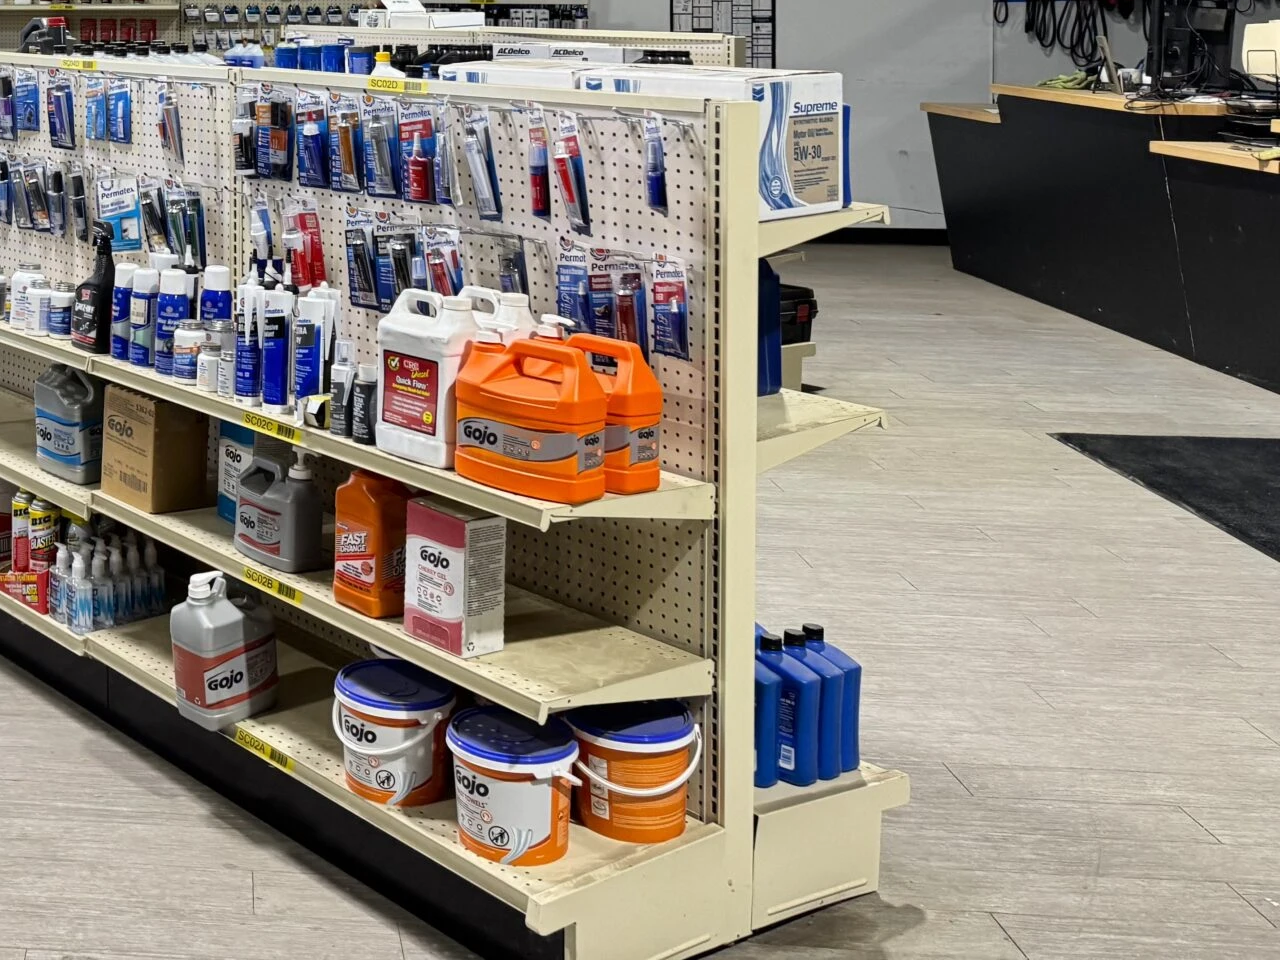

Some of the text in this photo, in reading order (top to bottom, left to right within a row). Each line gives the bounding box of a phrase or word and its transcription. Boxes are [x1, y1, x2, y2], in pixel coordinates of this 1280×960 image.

[497, 47, 531, 55] ACDelco
[370, 78, 398, 90] SC02D
[793, 100, 838, 116] Supreme
[400, 109, 432, 121] Permatex
[793, 129, 808, 139] Motor
[793, 144, 822, 161] 5W-30
[101, 187, 135, 200] Permatex
[591, 262, 641, 272] Permatex
[655, 269, 685, 279] Permatex
[403, 359, 419, 371] CRC
[411, 369, 430, 379] Diesel
[395, 375, 428, 390] Quick Flow
[244, 413, 274, 432] SC02C
[340, 531, 367, 546] FAST
[339, 543, 367, 553] ORANGE
[418, 563, 436, 577] CHERRY
[437, 573, 447, 581] GEL
[245, 568, 273, 589] SC02B
[238, 729, 266, 754] SC02A
